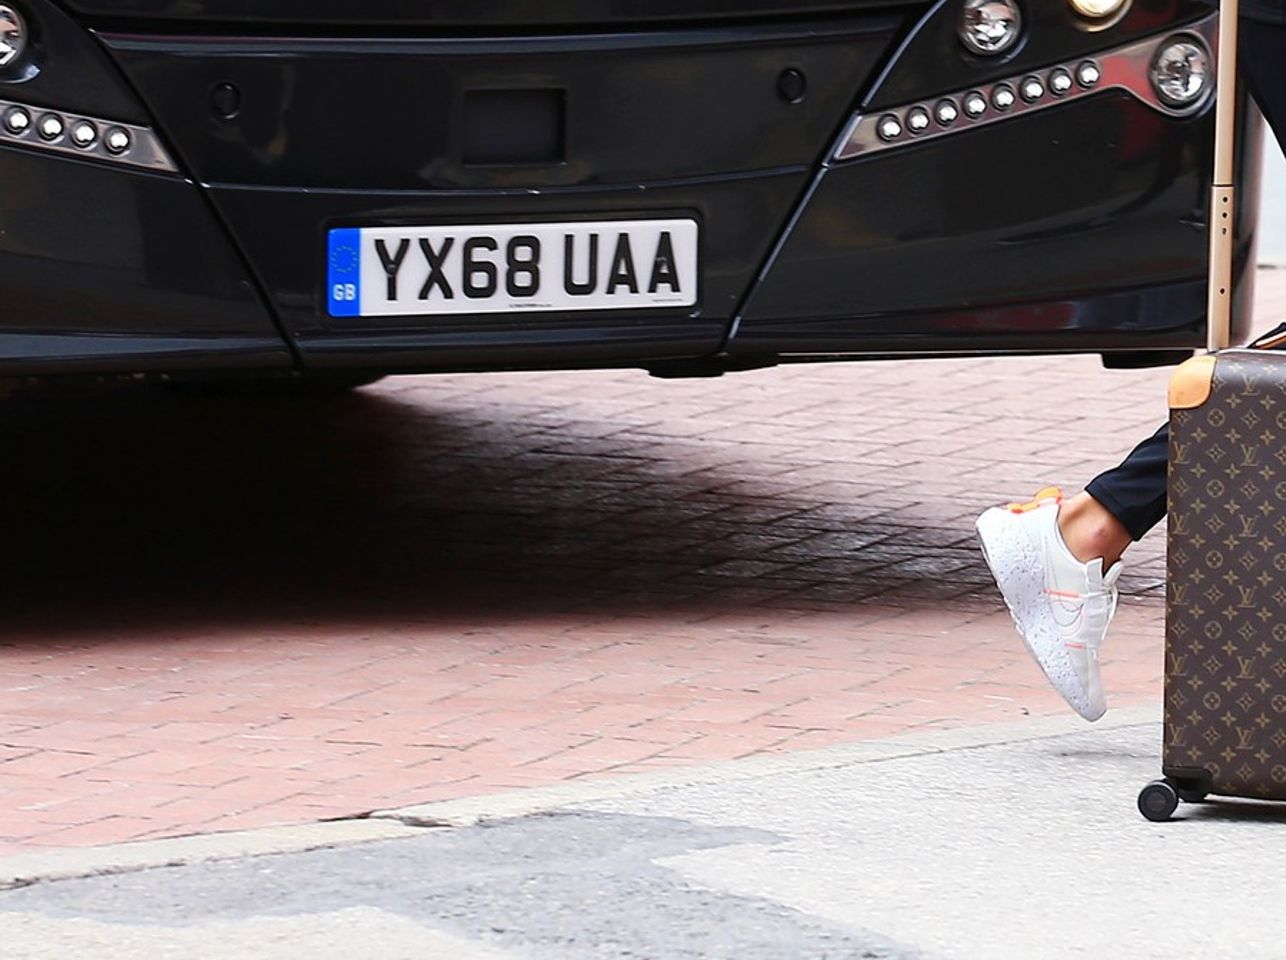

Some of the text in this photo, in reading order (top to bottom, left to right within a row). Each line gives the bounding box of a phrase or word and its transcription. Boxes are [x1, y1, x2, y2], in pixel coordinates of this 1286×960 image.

[374, 230, 682, 302] YX68 UAA
[333, 283, 357, 301] GB
